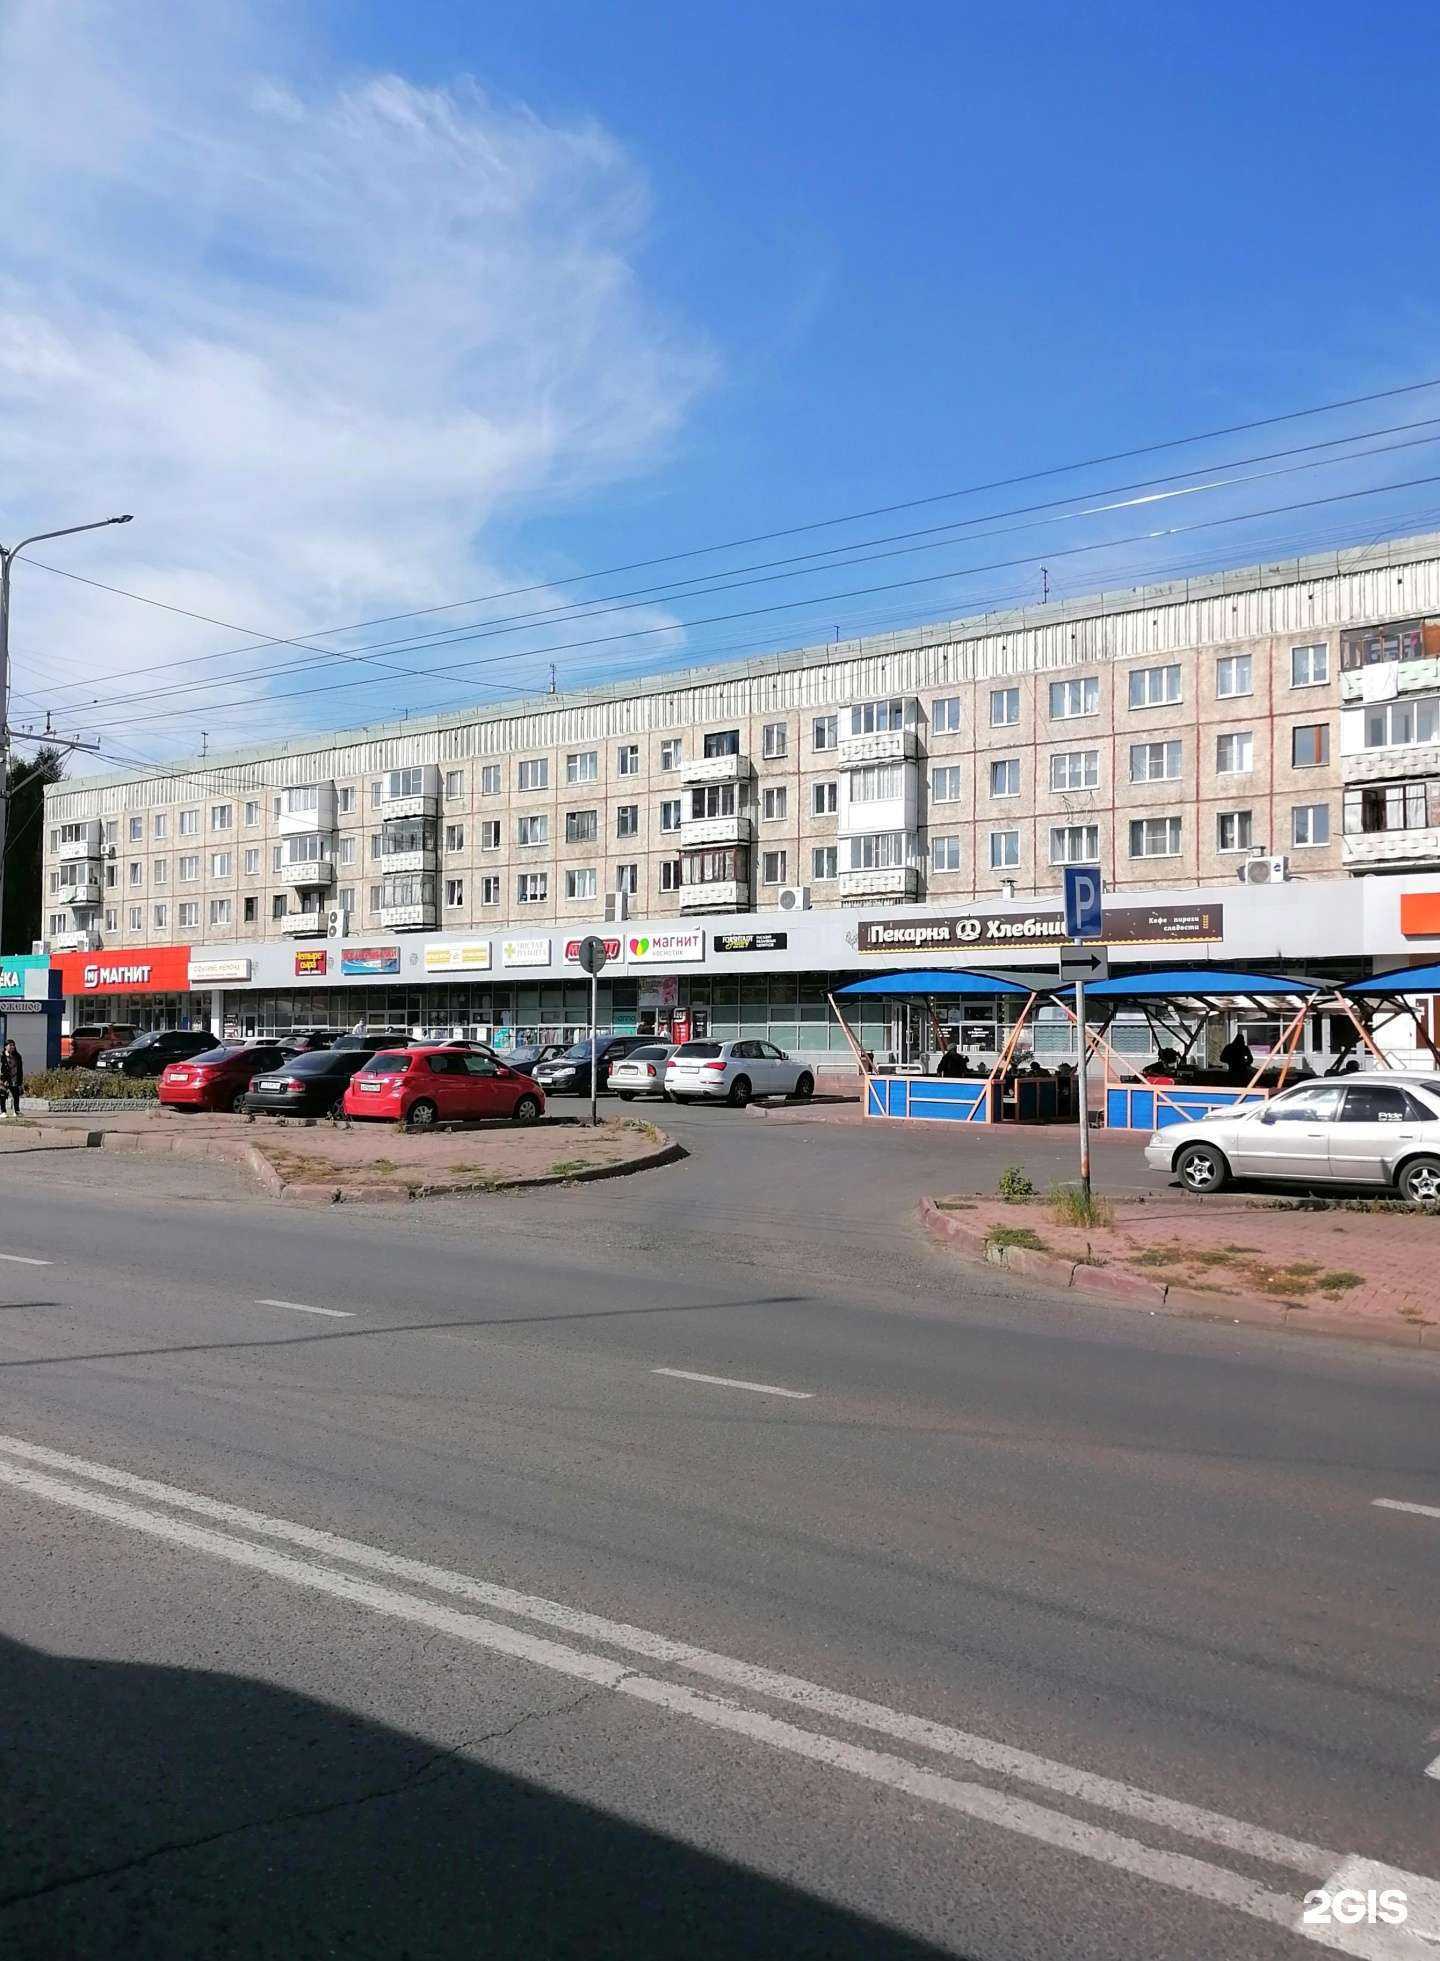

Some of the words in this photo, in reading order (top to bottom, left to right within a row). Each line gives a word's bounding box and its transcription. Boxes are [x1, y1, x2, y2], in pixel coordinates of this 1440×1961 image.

[1074, 876, 1095, 929] P
[1173, 916, 1200, 924] пироги
[871, 926, 950, 945] Пекарня
[100, 967, 151, 983] МАГНИТ
